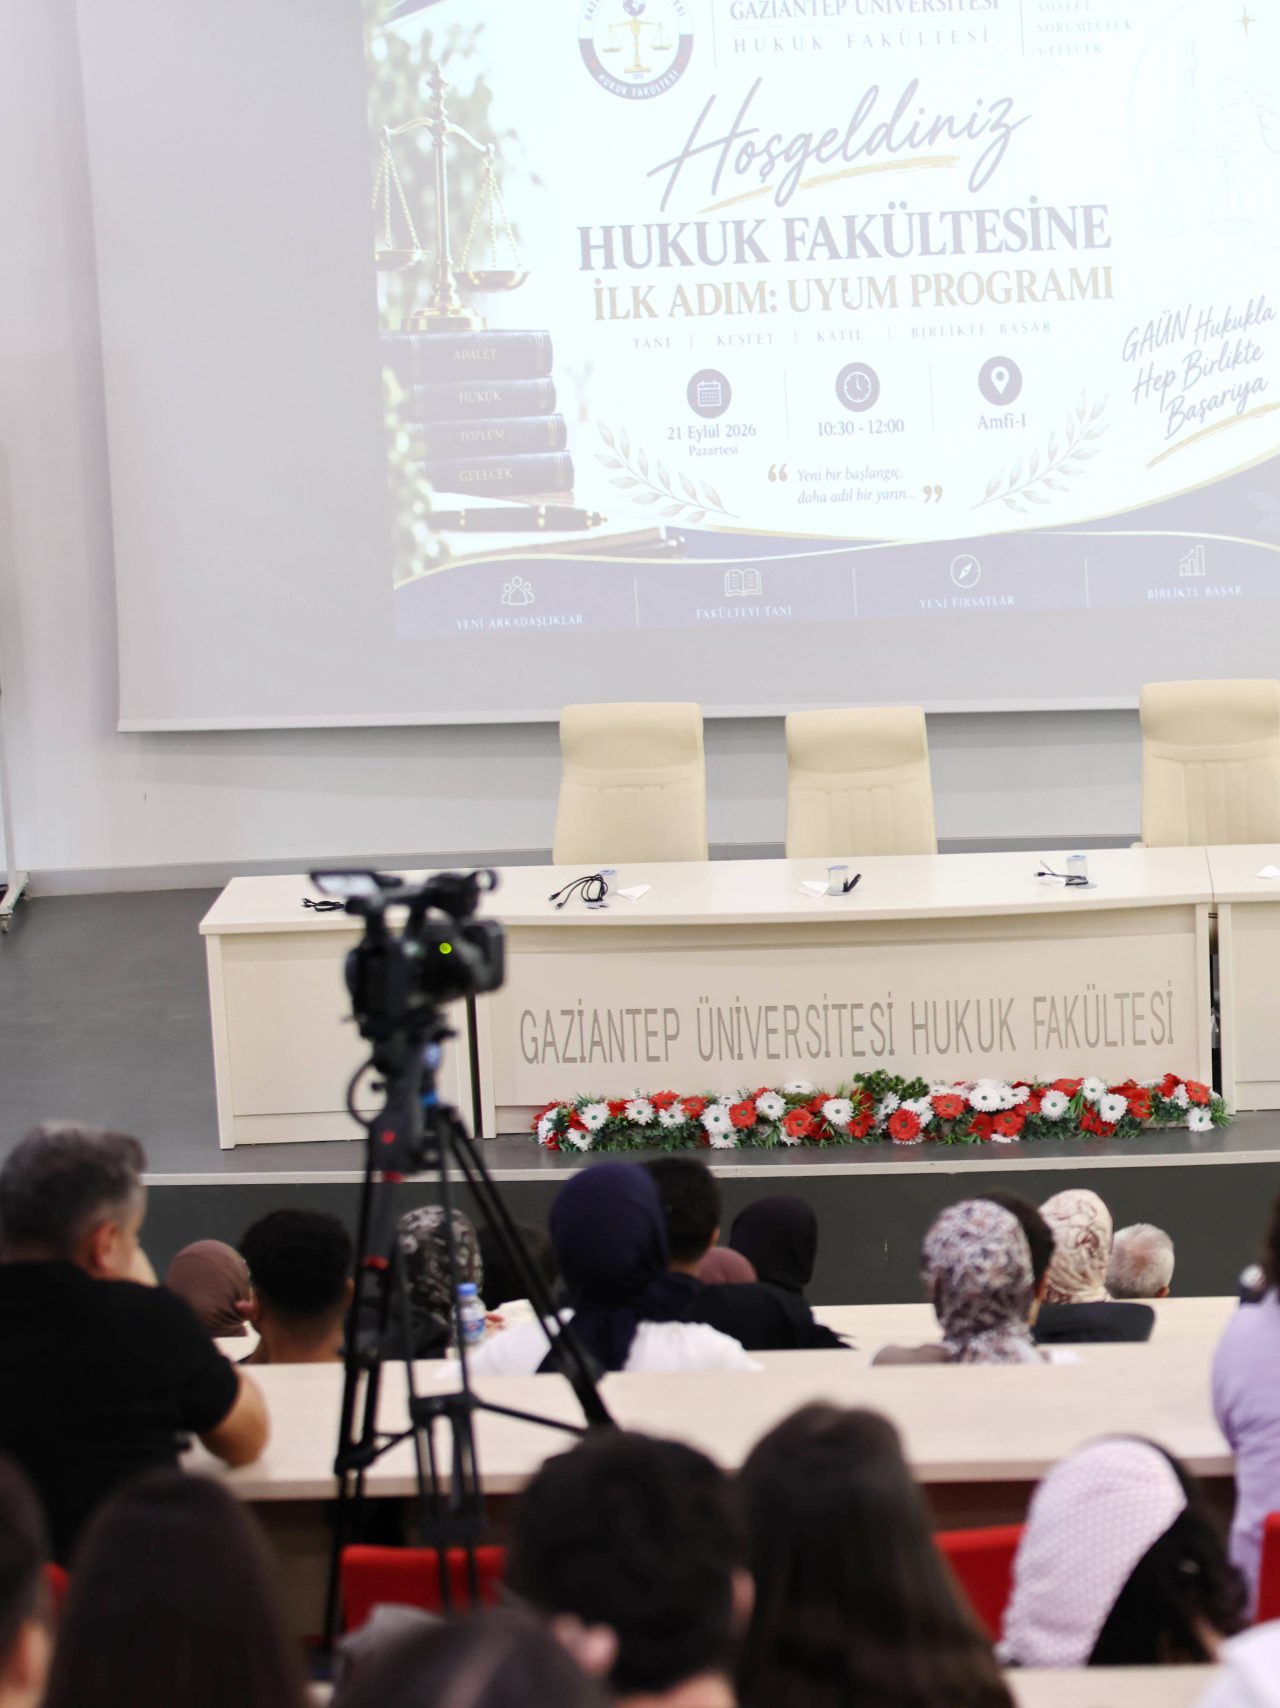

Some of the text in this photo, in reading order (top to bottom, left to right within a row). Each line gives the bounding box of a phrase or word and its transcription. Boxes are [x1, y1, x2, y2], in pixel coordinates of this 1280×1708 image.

[734, 25, 988, 53] HUKUK FAKÜLTESİ
[645, 76, 1033, 213] Hoşgeldiniz
[576, 195, 1113, 271] HUKUK FAKÜLTESİNE
[592, 265, 1115, 322] İLK ADIM: UYUM PROGRAMI
[1122, 294, 1278, 363] GAÜN Hukukla
[1132, 337, 1264, 413] Hep Birlikte
[458, 390, 502, 404] HUKUK
[667, 423, 757, 443] 21 Eylül 2026
[817, 420, 855, 437] 10:30
[868, 418, 905, 434] 12:00
[689, 444, 739, 457] Pazartesi
[797, 468, 822, 482] Yeni
[797, 488, 827, 504] daha
[830, 487, 854, 503] adil
[456, 617, 484, 630] YENİ
[519, 979, 1174, 1065] GAZİANTEP ÜNİVERSİTESİ HUKUK FAKÜLTESİ
